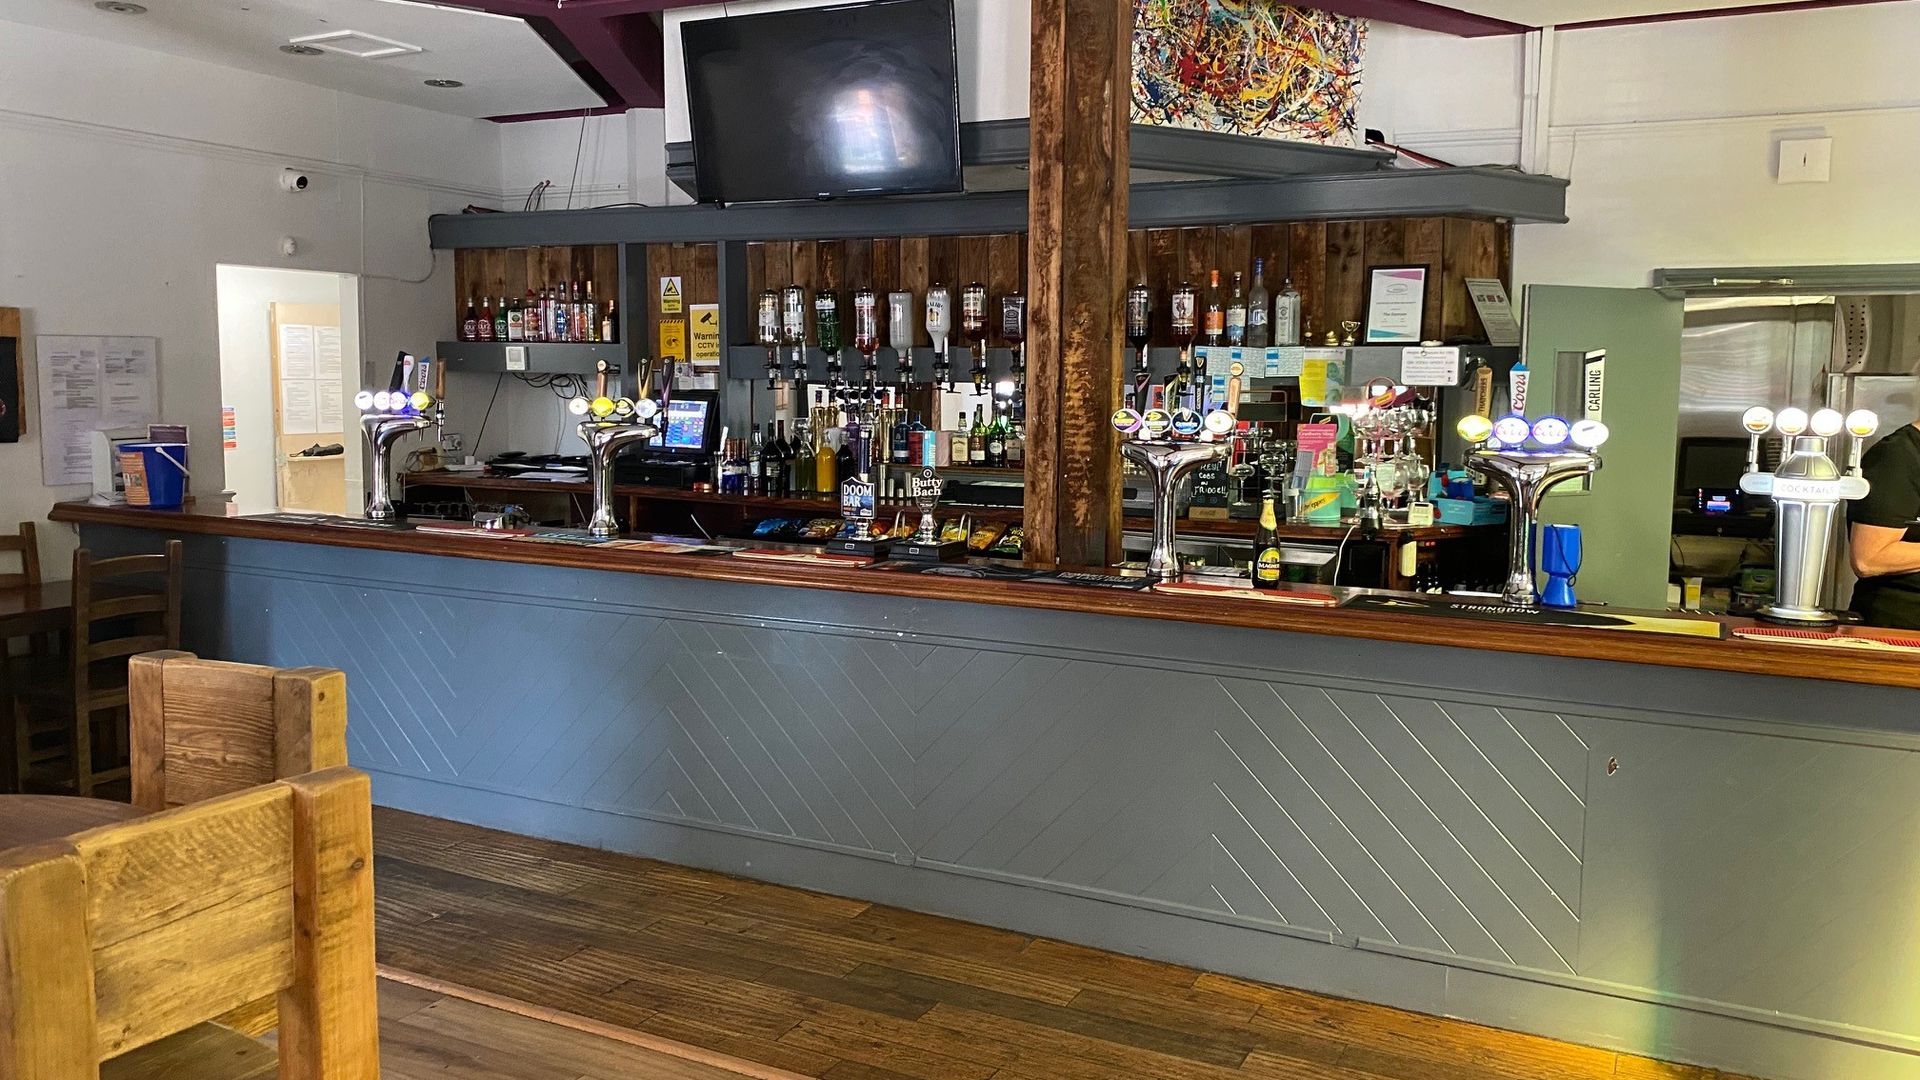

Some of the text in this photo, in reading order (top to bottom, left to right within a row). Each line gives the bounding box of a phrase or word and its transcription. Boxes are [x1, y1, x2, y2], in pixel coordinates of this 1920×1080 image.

[694, 332, 720, 340] Warnin
[1512, 374, 1526, 411] Coors
[1588, 370, 1601, 411] CARLING
[912, 477, 943, 488] Butty
[1780, 482, 1835, 494] COCKTAILS
[843, 484, 872, 497] DOOM
[912, 487, 941, 497] Bach
[843, 495, 862, 507] BAR
[1450, 603, 1539, 614] STRONGBOW
